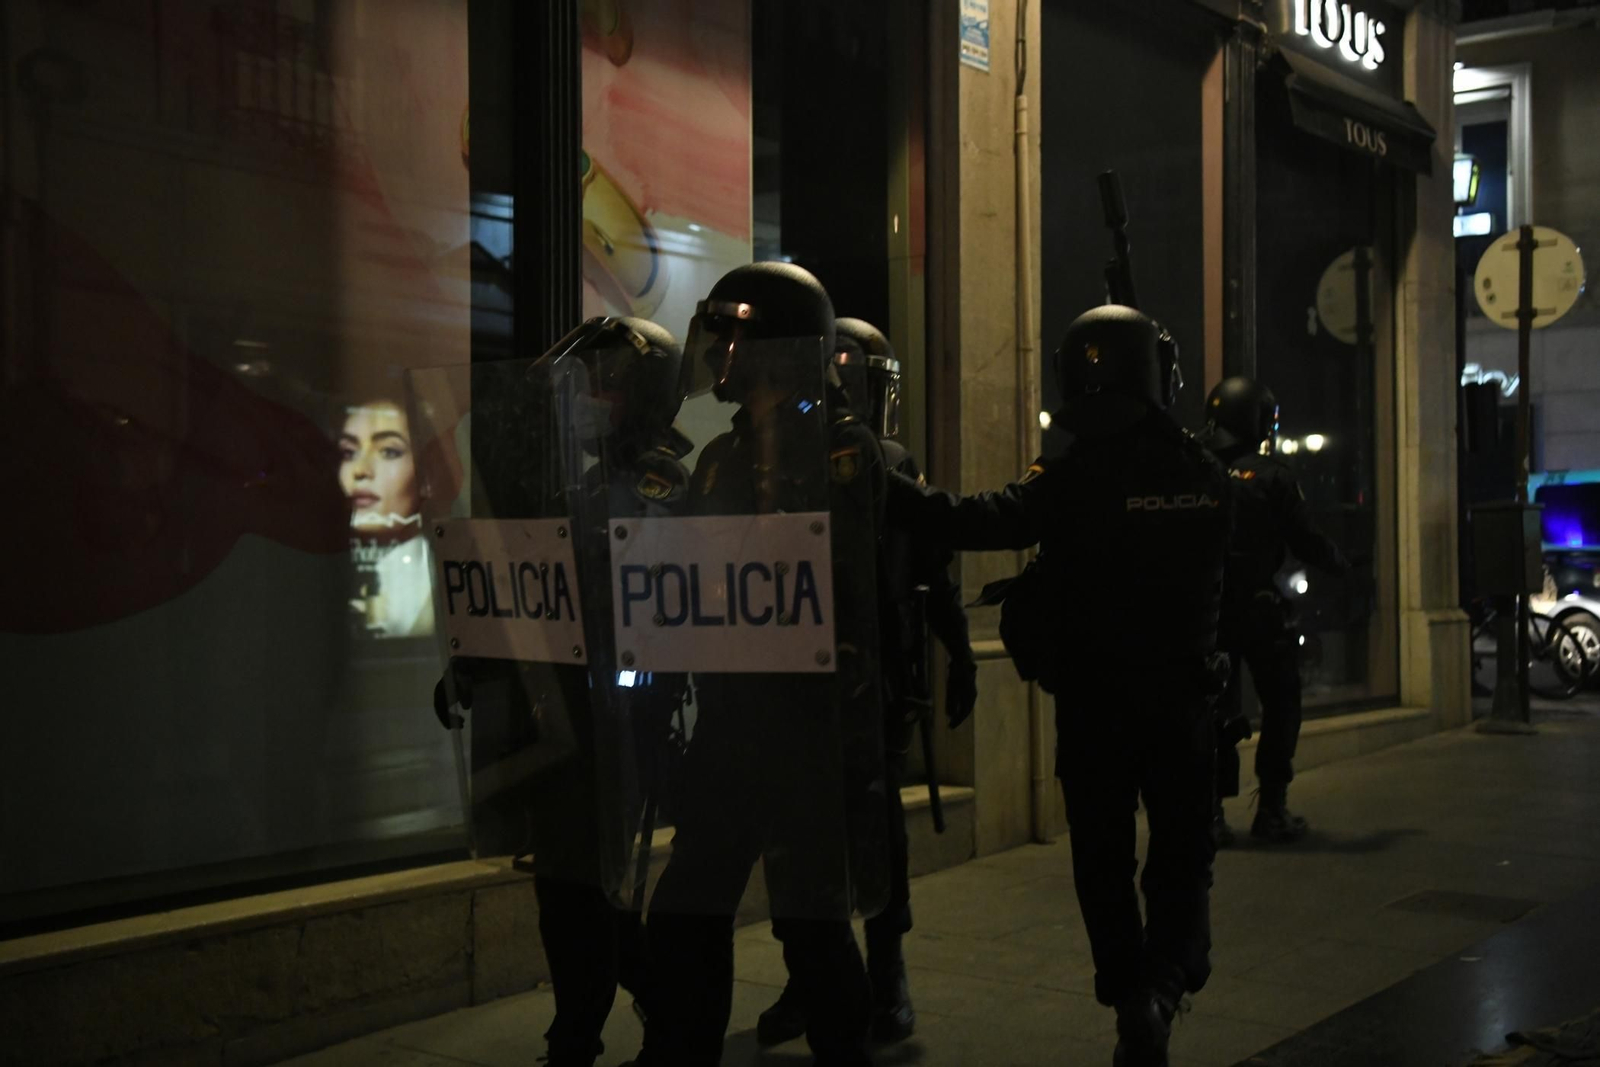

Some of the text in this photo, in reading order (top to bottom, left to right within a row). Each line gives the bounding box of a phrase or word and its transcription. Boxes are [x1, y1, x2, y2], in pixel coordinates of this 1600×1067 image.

[1343, 117, 1387, 156] TOUS
[1126, 493, 1214, 513] POLICIA
[443, 560, 576, 622] POLICIA
[620, 560, 824, 628] POLICIA
